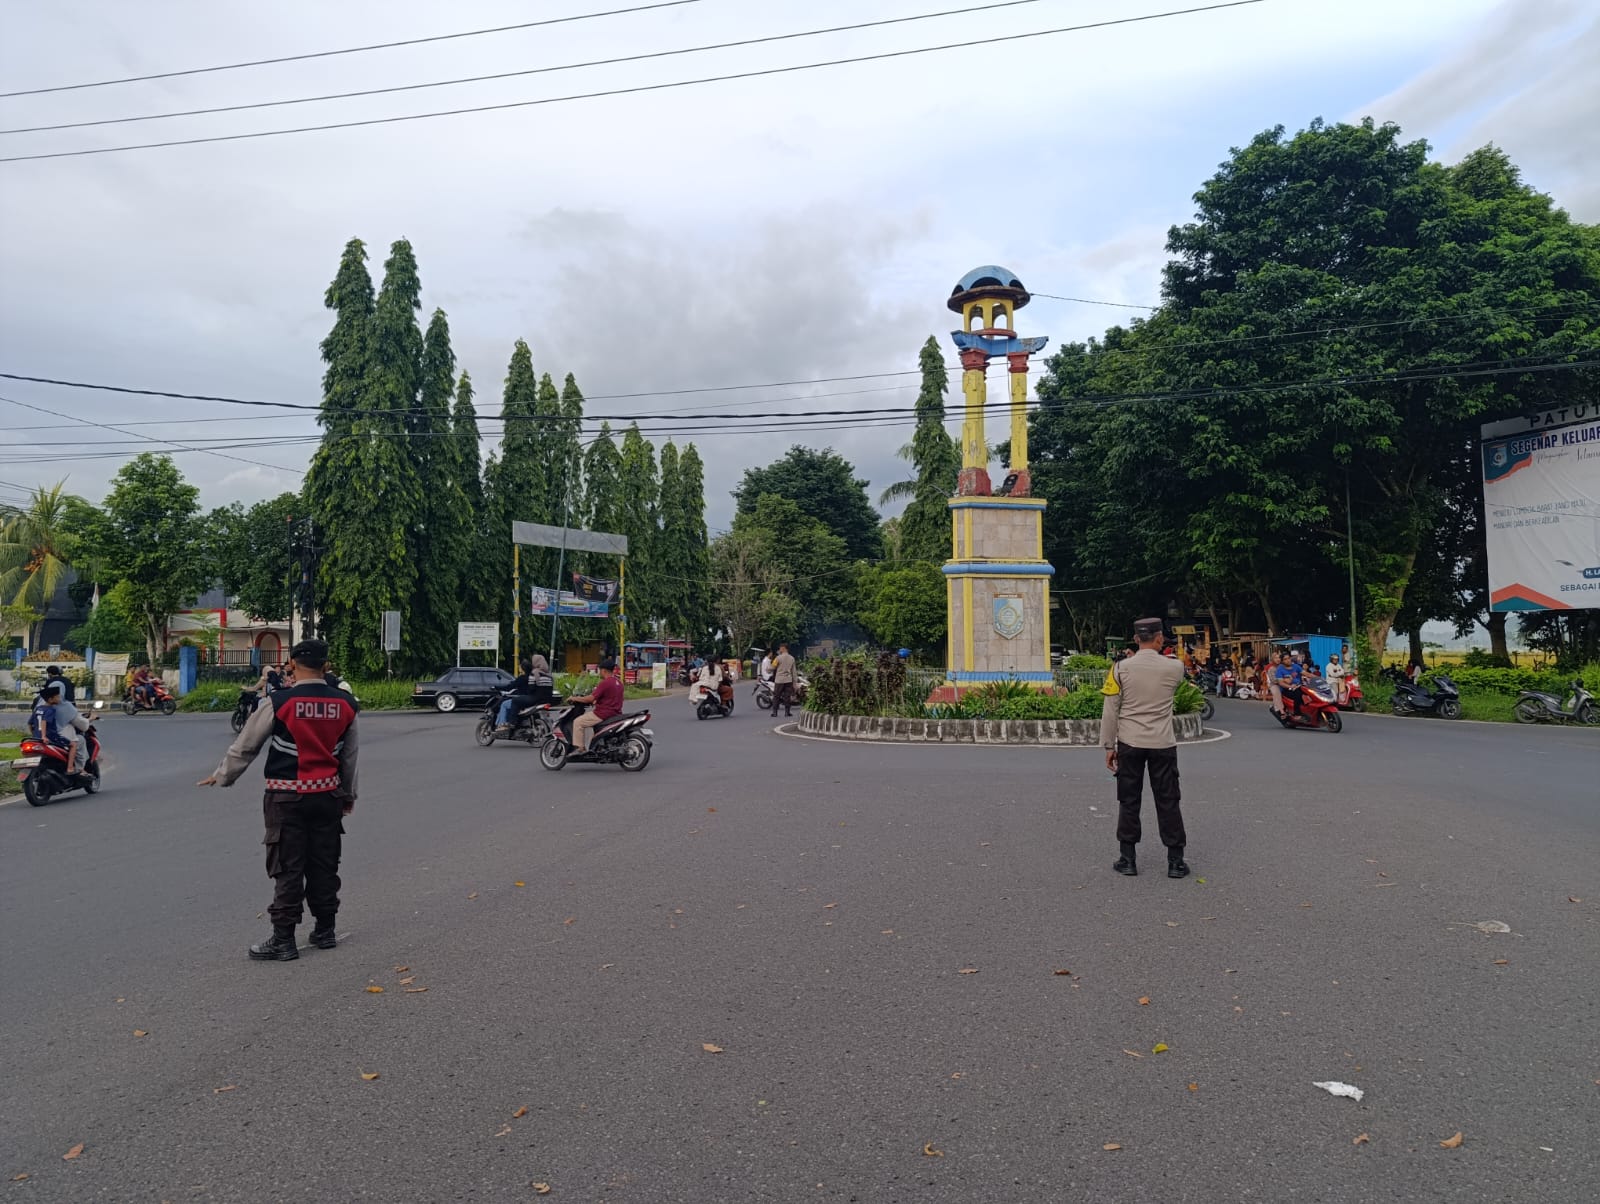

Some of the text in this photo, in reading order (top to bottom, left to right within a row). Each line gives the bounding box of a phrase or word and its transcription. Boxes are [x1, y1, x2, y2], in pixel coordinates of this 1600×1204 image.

[1511, 434, 1558, 455] SEGENAP
[1560, 583, 1597, 592] SEBAGAI
[295, 702, 340, 719] POLISI
